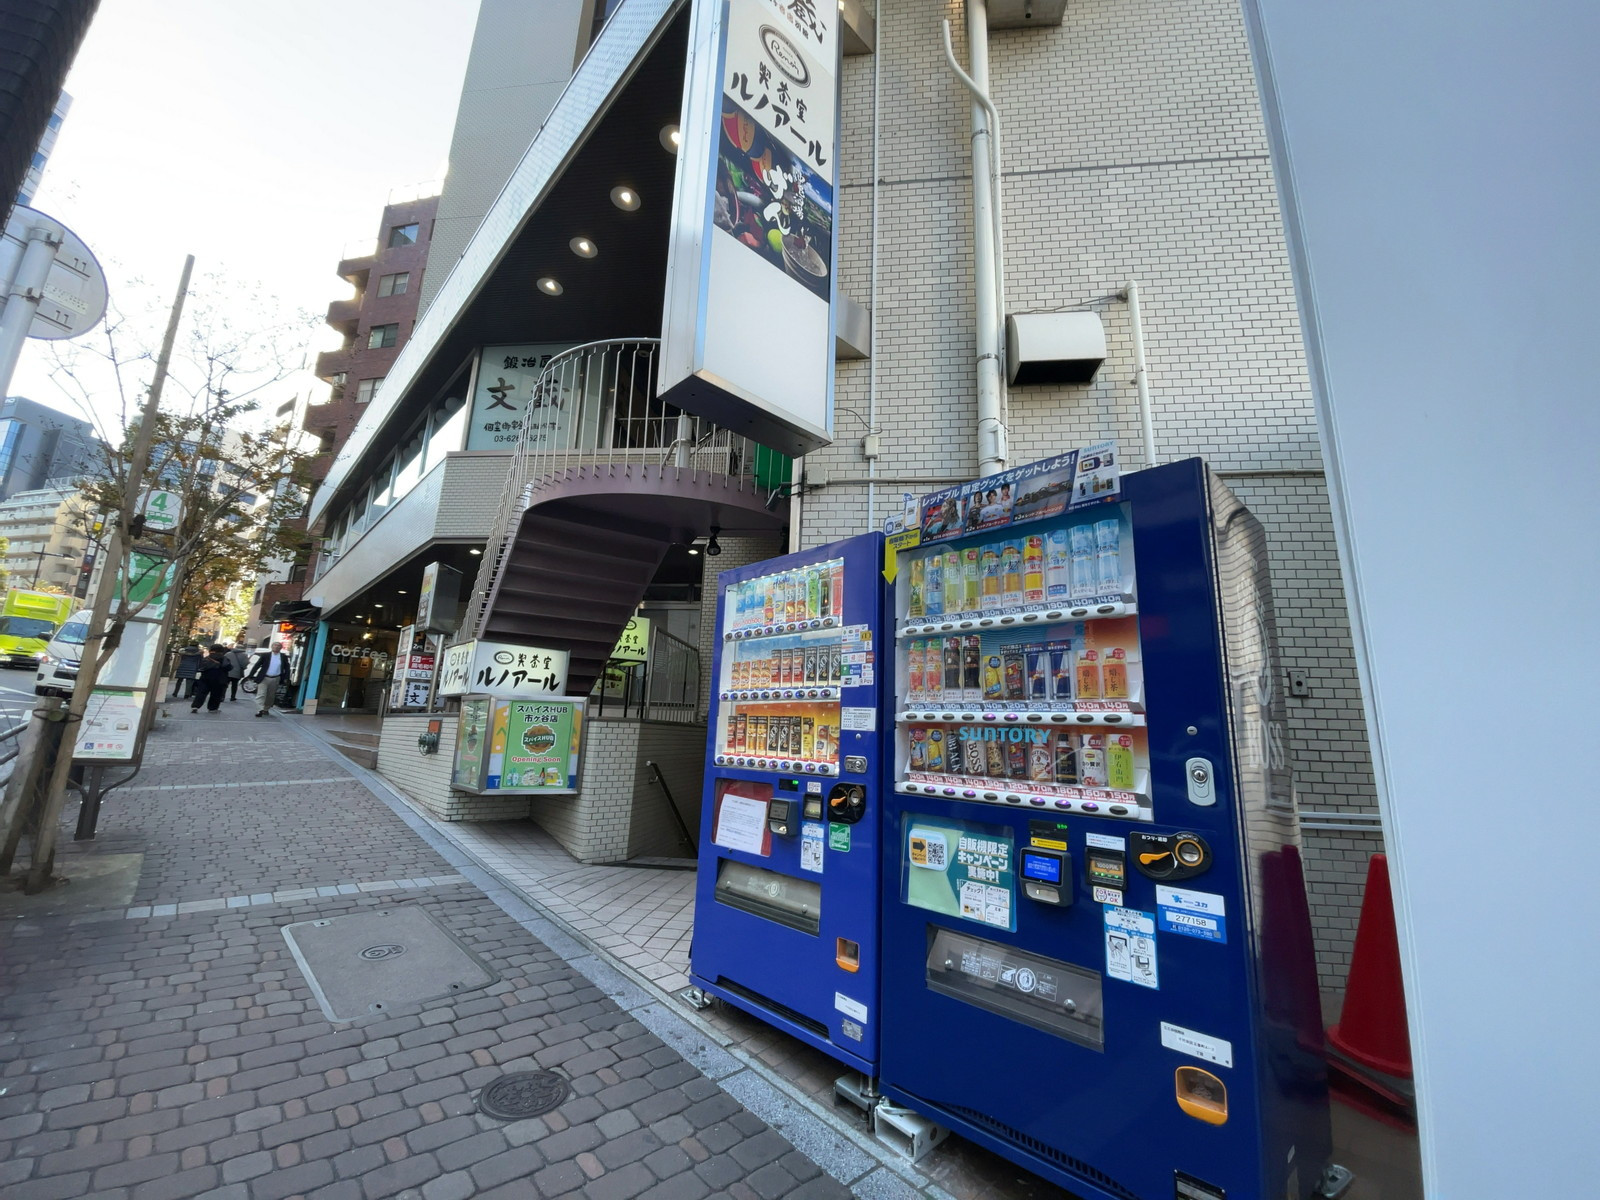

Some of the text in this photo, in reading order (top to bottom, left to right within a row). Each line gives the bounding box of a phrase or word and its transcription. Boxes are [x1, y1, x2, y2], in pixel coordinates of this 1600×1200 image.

[759, 61, 807, 123] 喫茶室
[731, 72, 827, 166] ルノアール
[150, 493, 168, 511] 4
[921, 488, 960, 507] レッドブル
[1047, 601, 1069, 609] 190円
[1071, 598, 1094, 606] 140円
[1096, 595, 1121, 603] 140円
[620, 634, 639, 644] 茶室
[331, 645, 388, 661] Coffee
[517, 653, 552, 669] 喫茶室
[477, 666, 560, 691] ルノアール
[960, 726, 1052, 744] SUNTORY
[968, 742, 983, 772] BOSS
[1082, 789, 1106, 798] 160円
[1110, 791, 1135, 801] 150円
[959, 837, 1009, 858] 自販機限定
[958, 850, 1008, 871] キャンペーン
[1176, 914, 1207, 926] 277158
